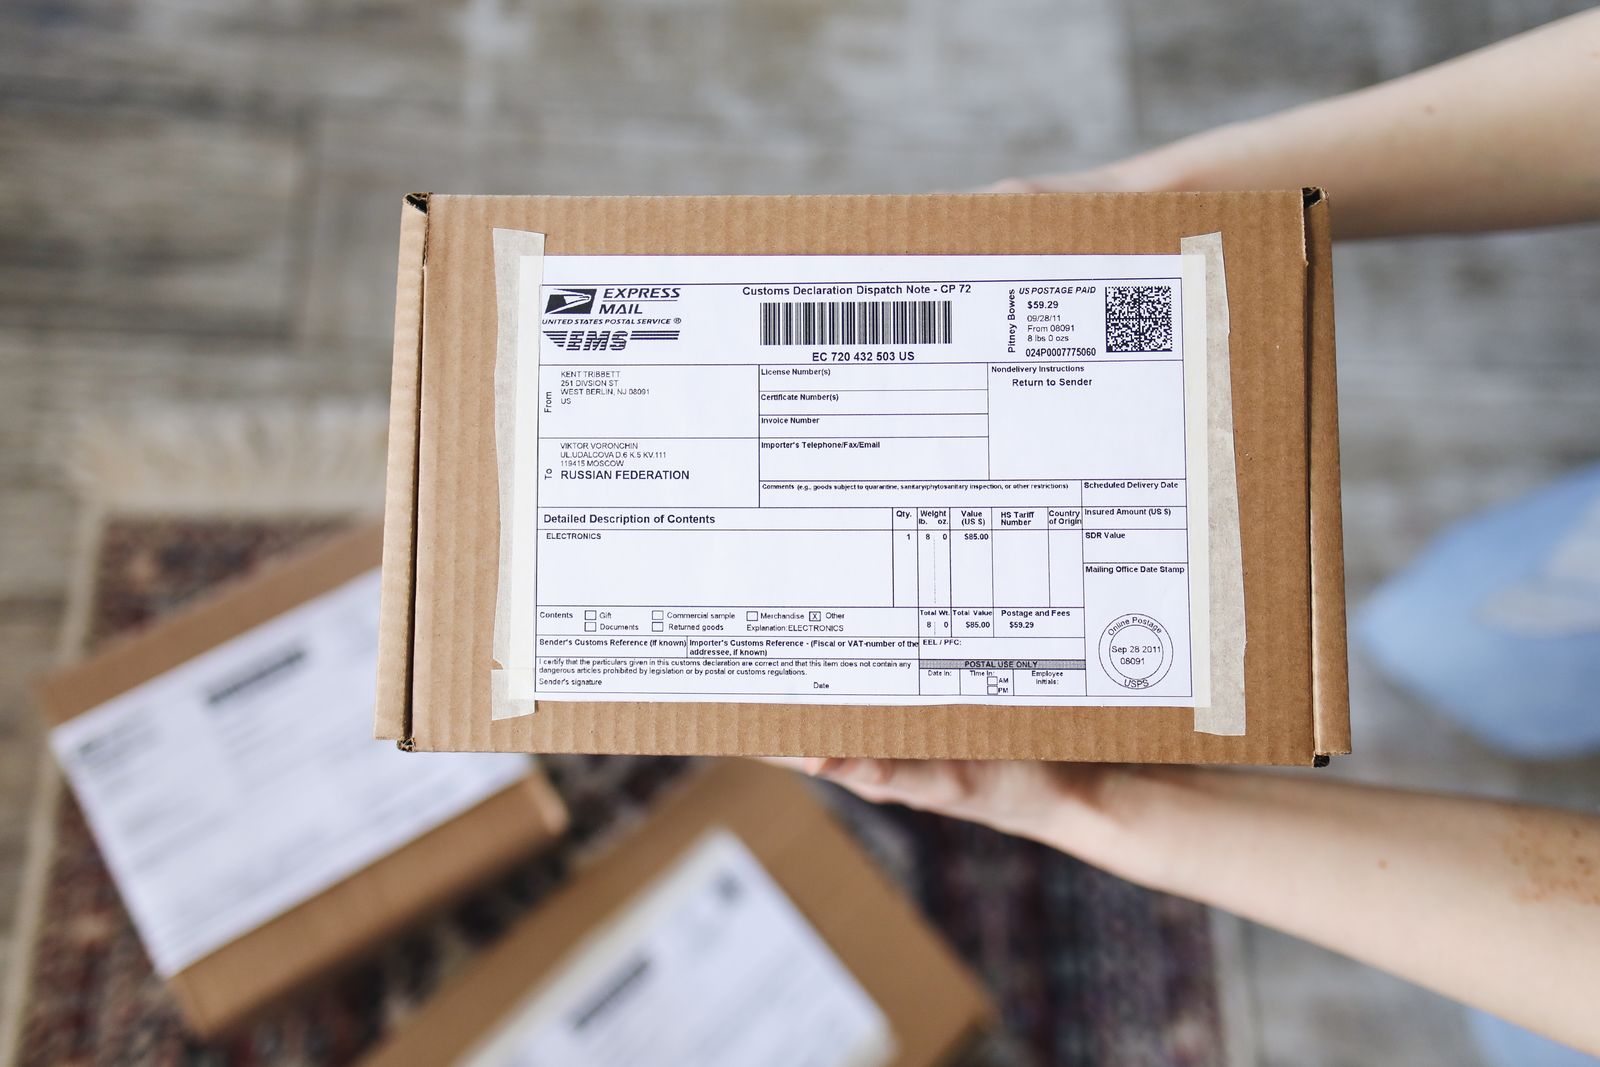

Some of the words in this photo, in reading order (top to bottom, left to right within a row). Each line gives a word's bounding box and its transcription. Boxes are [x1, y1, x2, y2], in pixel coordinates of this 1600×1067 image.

[603, 288, 681, 298] EXPRESS
[743, 287, 790, 295] Customs
[793, 286, 852, 295] Declaration
[857, 285, 902, 296] Dispatch
[906, 285, 930, 294] Note
[941, 284, 956, 293] CP
[959, 284, 971, 293] 72
[1075, 286, 1096, 294] PAID
[1007, 289, 1015, 320] Bowes
[1027, 301, 1059, 309] $59.29
[599, 304, 643, 314] MAIL
[1050, 324, 1074, 332] 08091
[566, 330, 628, 351] EMS
[1008, 323, 1017, 353] Pitney
[812, 352, 827, 361] EC
[831, 352, 850, 361] 720
[853, 352, 873, 361] 432
[876, 352, 895, 361] 503
[899, 351, 914, 361] US
[1026, 348, 1096, 357] 024P0007775060
[792, 368, 830, 376] Number(s)
[992, 366, 1037, 374] Nondelivery
[1059, 378, 1092, 386] Sender
[800, 394, 839, 402] Number(s)
[544, 392, 552, 413] From
[561, 470, 612, 479] RUSSIAN
[616, 470, 689, 479] FEDERATION
[896, 510, 912, 519] Qty.
[920, 510, 946, 518] Weight
[1050, 510, 1080, 519] Country
[1148, 508, 1162, 516] (US
[544, 514, 586, 523] Detailed
[590, 514, 650, 525] Description
[654, 515, 664, 523] of
[667, 515, 715, 523] Contents
[1085, 566, 1113, 574] Mailing
[1160, 566, 1185, 574] Stamp
[1108, 619, 1129, 636] Online
[1132, 617, 1162, 633] Postage
[1112, 646, 1127, 654] Sep
[1120, 657, 1144, 665] 08091
[649, 667, 684, 675] legislation
[1124, 679, 1149, 687] USPS
